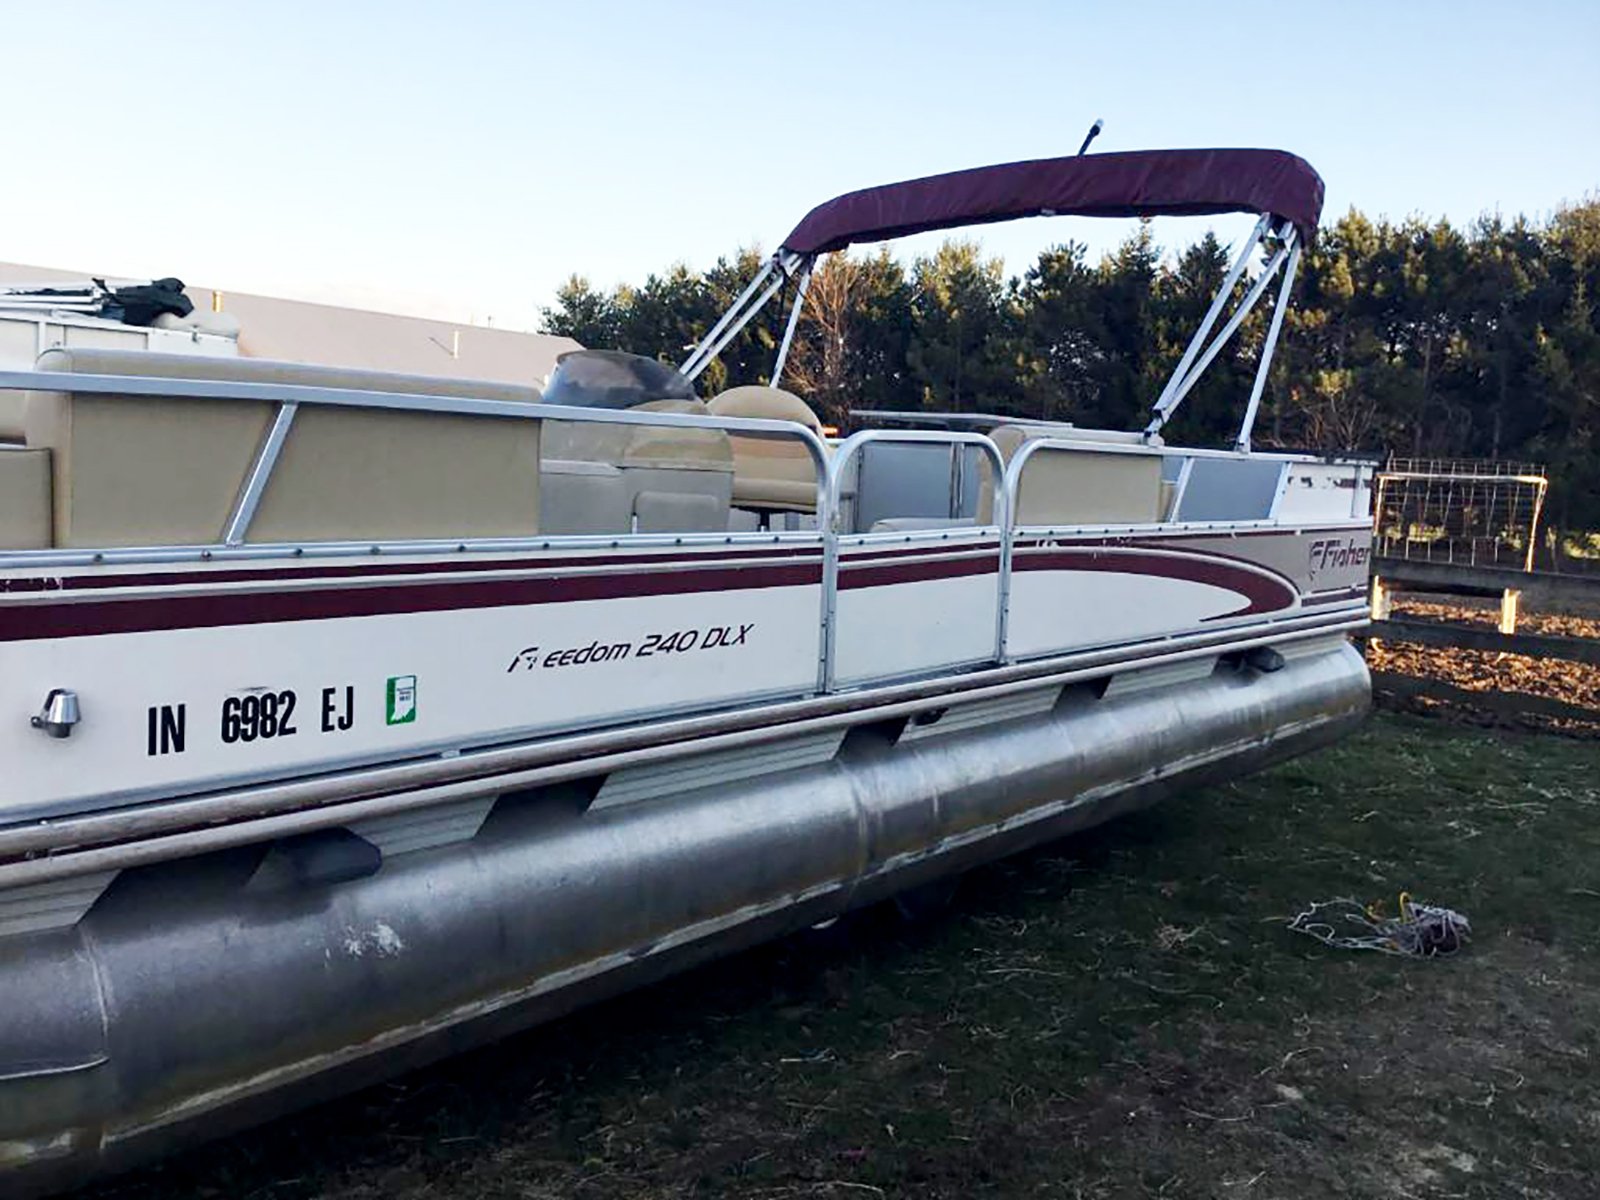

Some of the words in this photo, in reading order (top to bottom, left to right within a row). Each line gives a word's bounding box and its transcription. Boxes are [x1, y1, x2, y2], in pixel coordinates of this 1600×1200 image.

[635, 629, 699, 658] 240
[700, 622, 756, 651] DLX
[147, 703, 186, 756] IN
[221, 689, 297, 744] 6982
[321, 685, 354, 733] EJ
